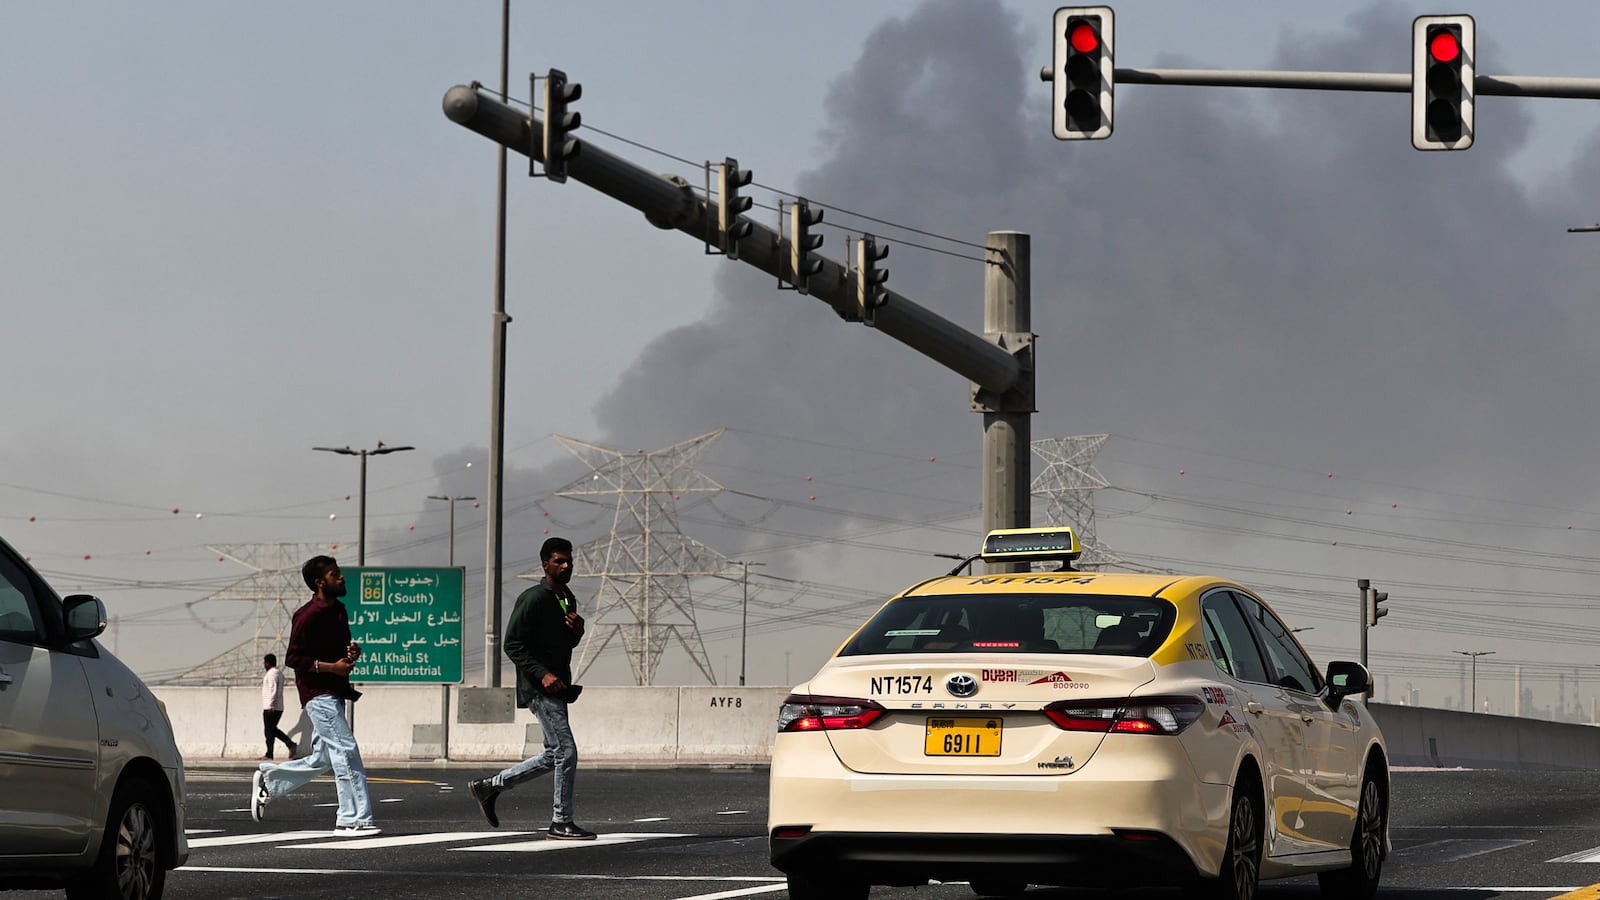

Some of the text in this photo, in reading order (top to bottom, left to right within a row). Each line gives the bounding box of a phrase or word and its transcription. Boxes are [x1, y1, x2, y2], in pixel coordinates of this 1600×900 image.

[364, 587, 381, 599] 86
[388, 592, 434, 605] (South)
[385, 611, 421, 625] الخيل
[427, 611, 460, 626] شارع
[402, 633, 427, 650] علي
[434, 634, 459, 647] جبل
[370, 652, 381, 663] Al
[384, 652, 412, 663] Khail
[416, 652, 429, 663] St
[373, 665, 387, 676] Ali
[391, 665, 442, 676] Industrial
[1047, 674, 1066, 683] RTA
[871, 676, 933, 695] NT1574
[944, 734, 980, 753] 6911
